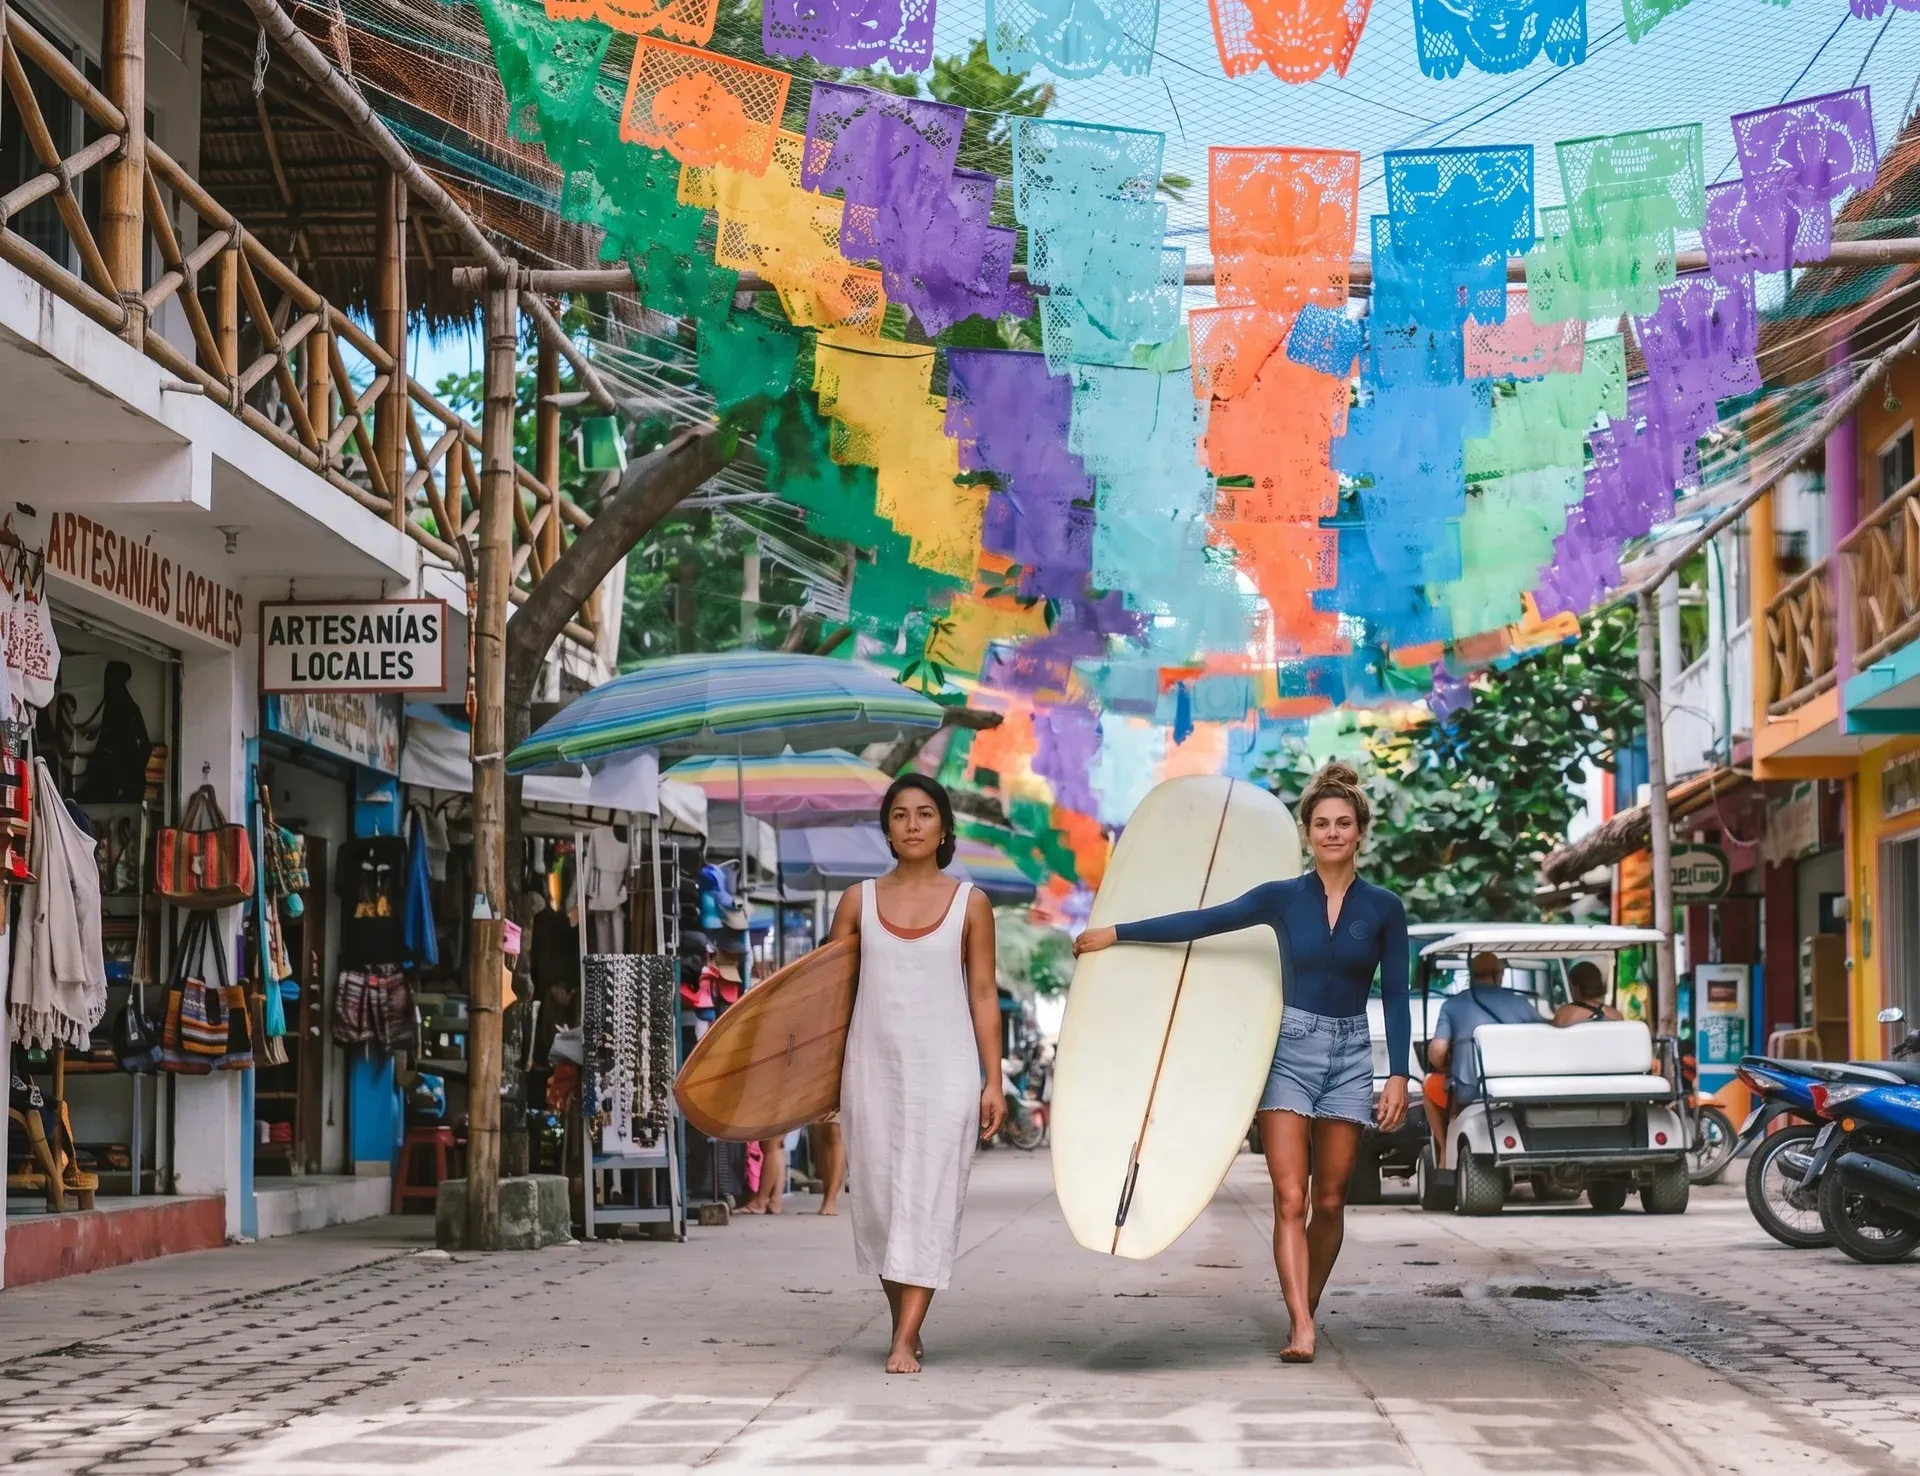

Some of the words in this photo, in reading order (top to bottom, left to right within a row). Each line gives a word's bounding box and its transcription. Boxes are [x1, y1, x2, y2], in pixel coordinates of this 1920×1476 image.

[46, 511, 171, 616] ARTESANÍAS
[175, 564, 243, 648] LOCALES
[268, 608, 438, 645] ARTESANÍAS
[291, 651, 414, 681] LOCALES
